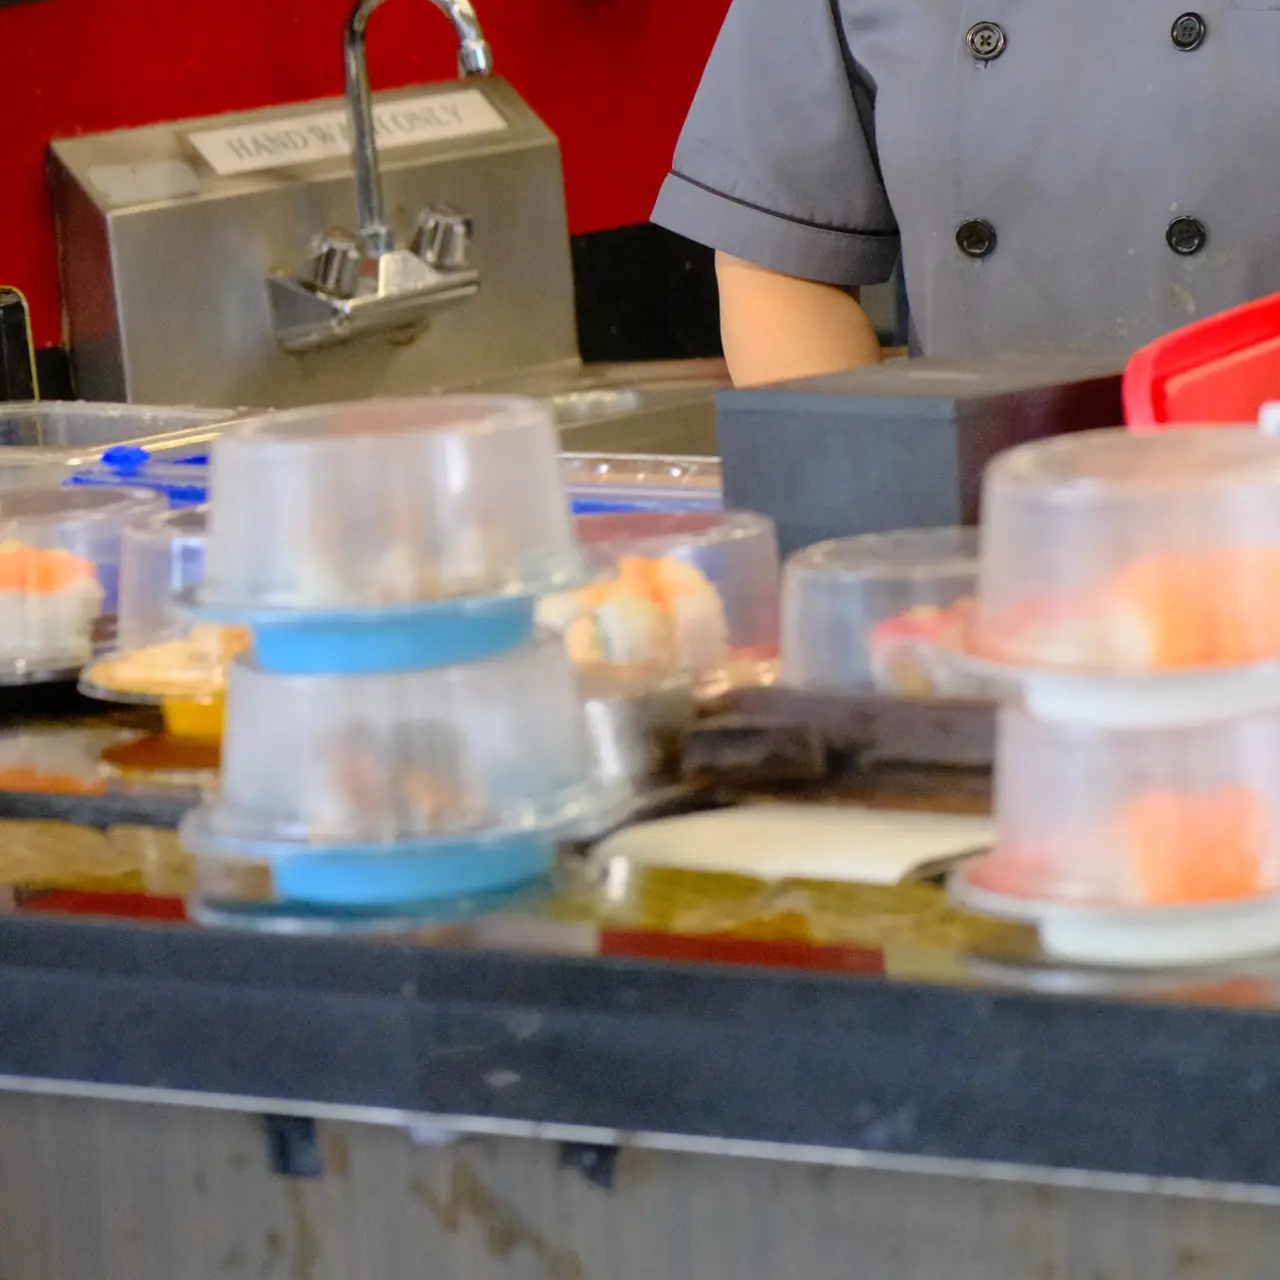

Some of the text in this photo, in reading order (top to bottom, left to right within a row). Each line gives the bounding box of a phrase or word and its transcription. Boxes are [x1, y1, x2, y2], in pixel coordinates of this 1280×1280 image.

[226, 102, 466, 161] HAND WH ONLY
